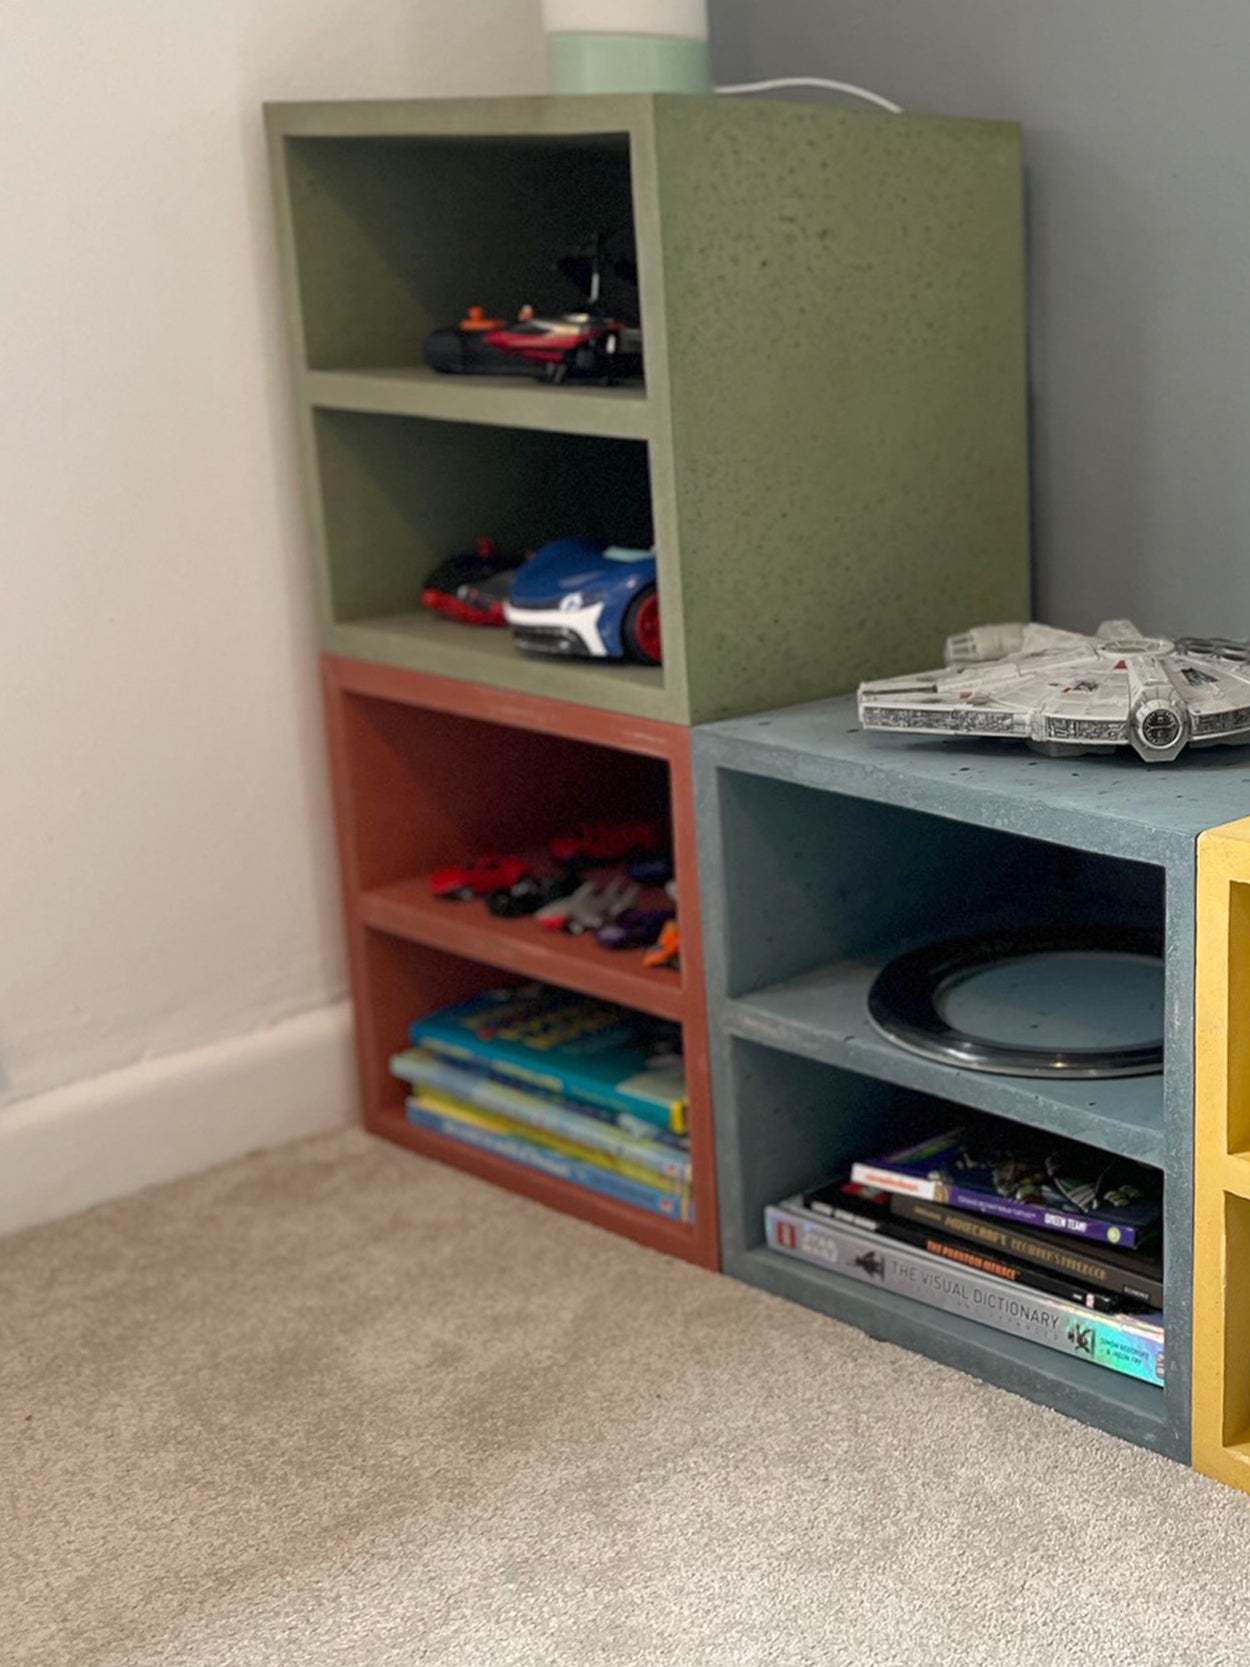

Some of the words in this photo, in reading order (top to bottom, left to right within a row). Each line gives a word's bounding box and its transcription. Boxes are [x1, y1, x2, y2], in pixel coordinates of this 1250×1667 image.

[892, 1260, 919, 1281] THE
[920, 1271, 969, 1300] VISUAL
[973, 1288, 1060, 1329] DICTIONARY
